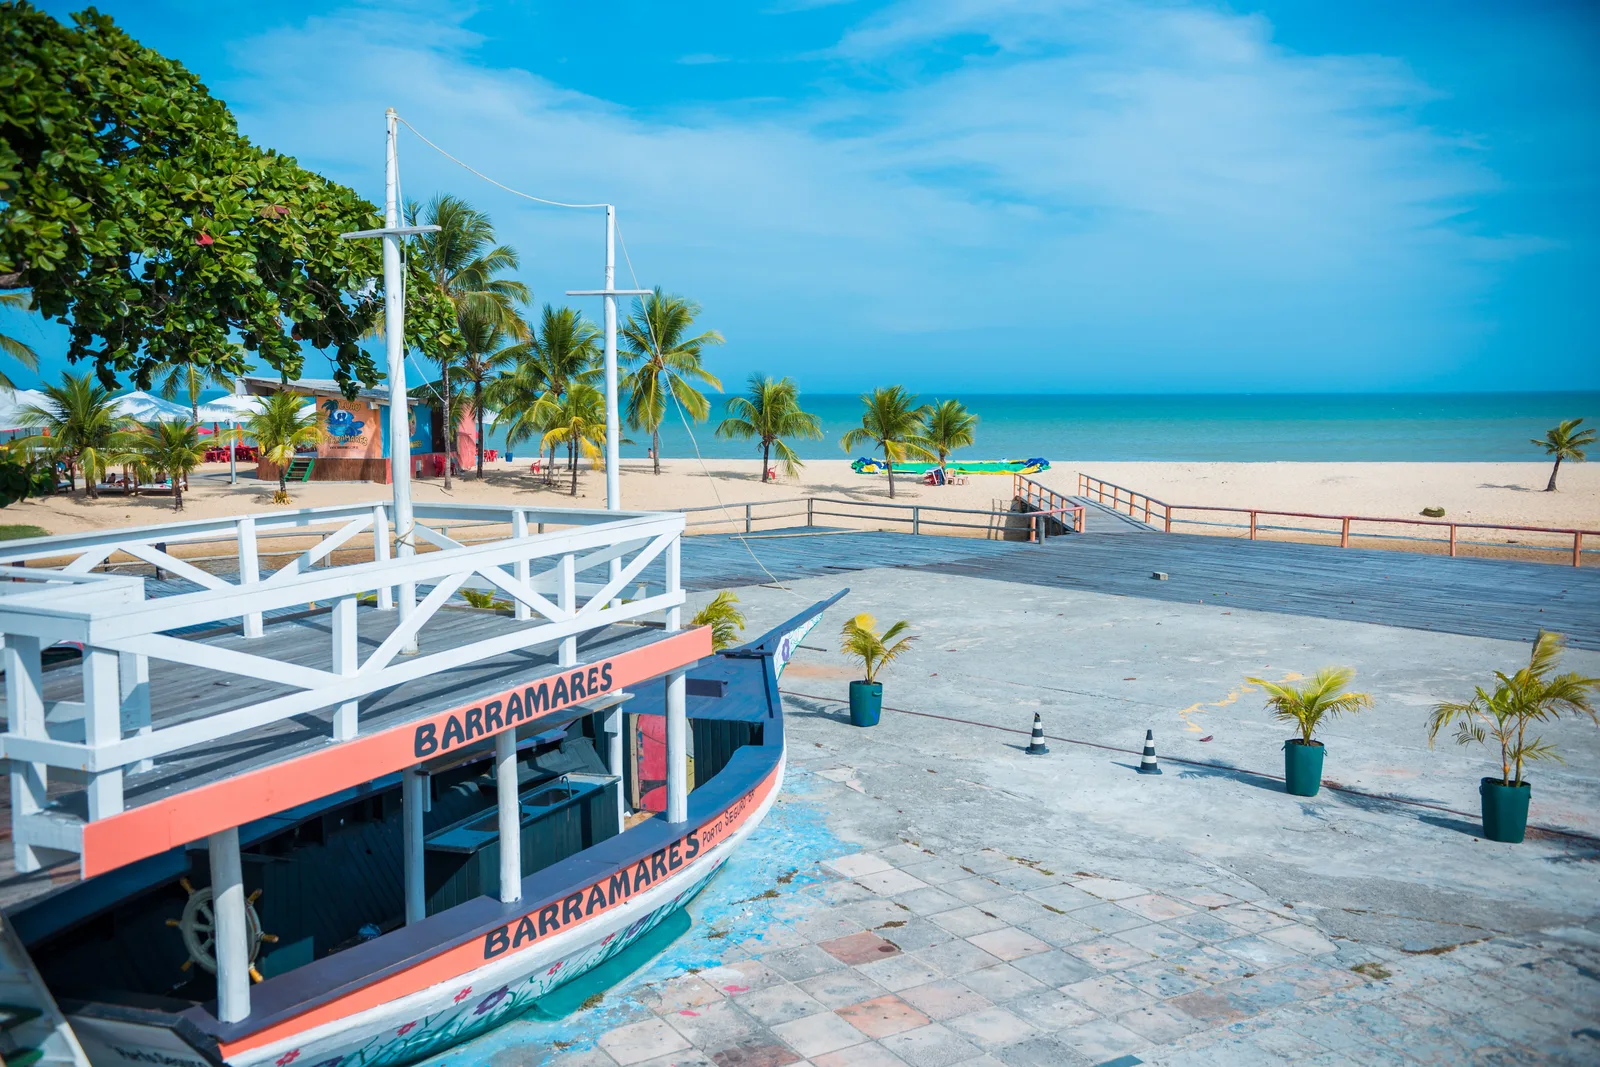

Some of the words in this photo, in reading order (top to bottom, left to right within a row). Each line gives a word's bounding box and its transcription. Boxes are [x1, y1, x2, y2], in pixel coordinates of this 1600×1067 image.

[414, 662, 612, 758] BARRAMARES
[484, 829, 699, 960] BARRAMARES
[702, 821, 722, 847] PORTO
